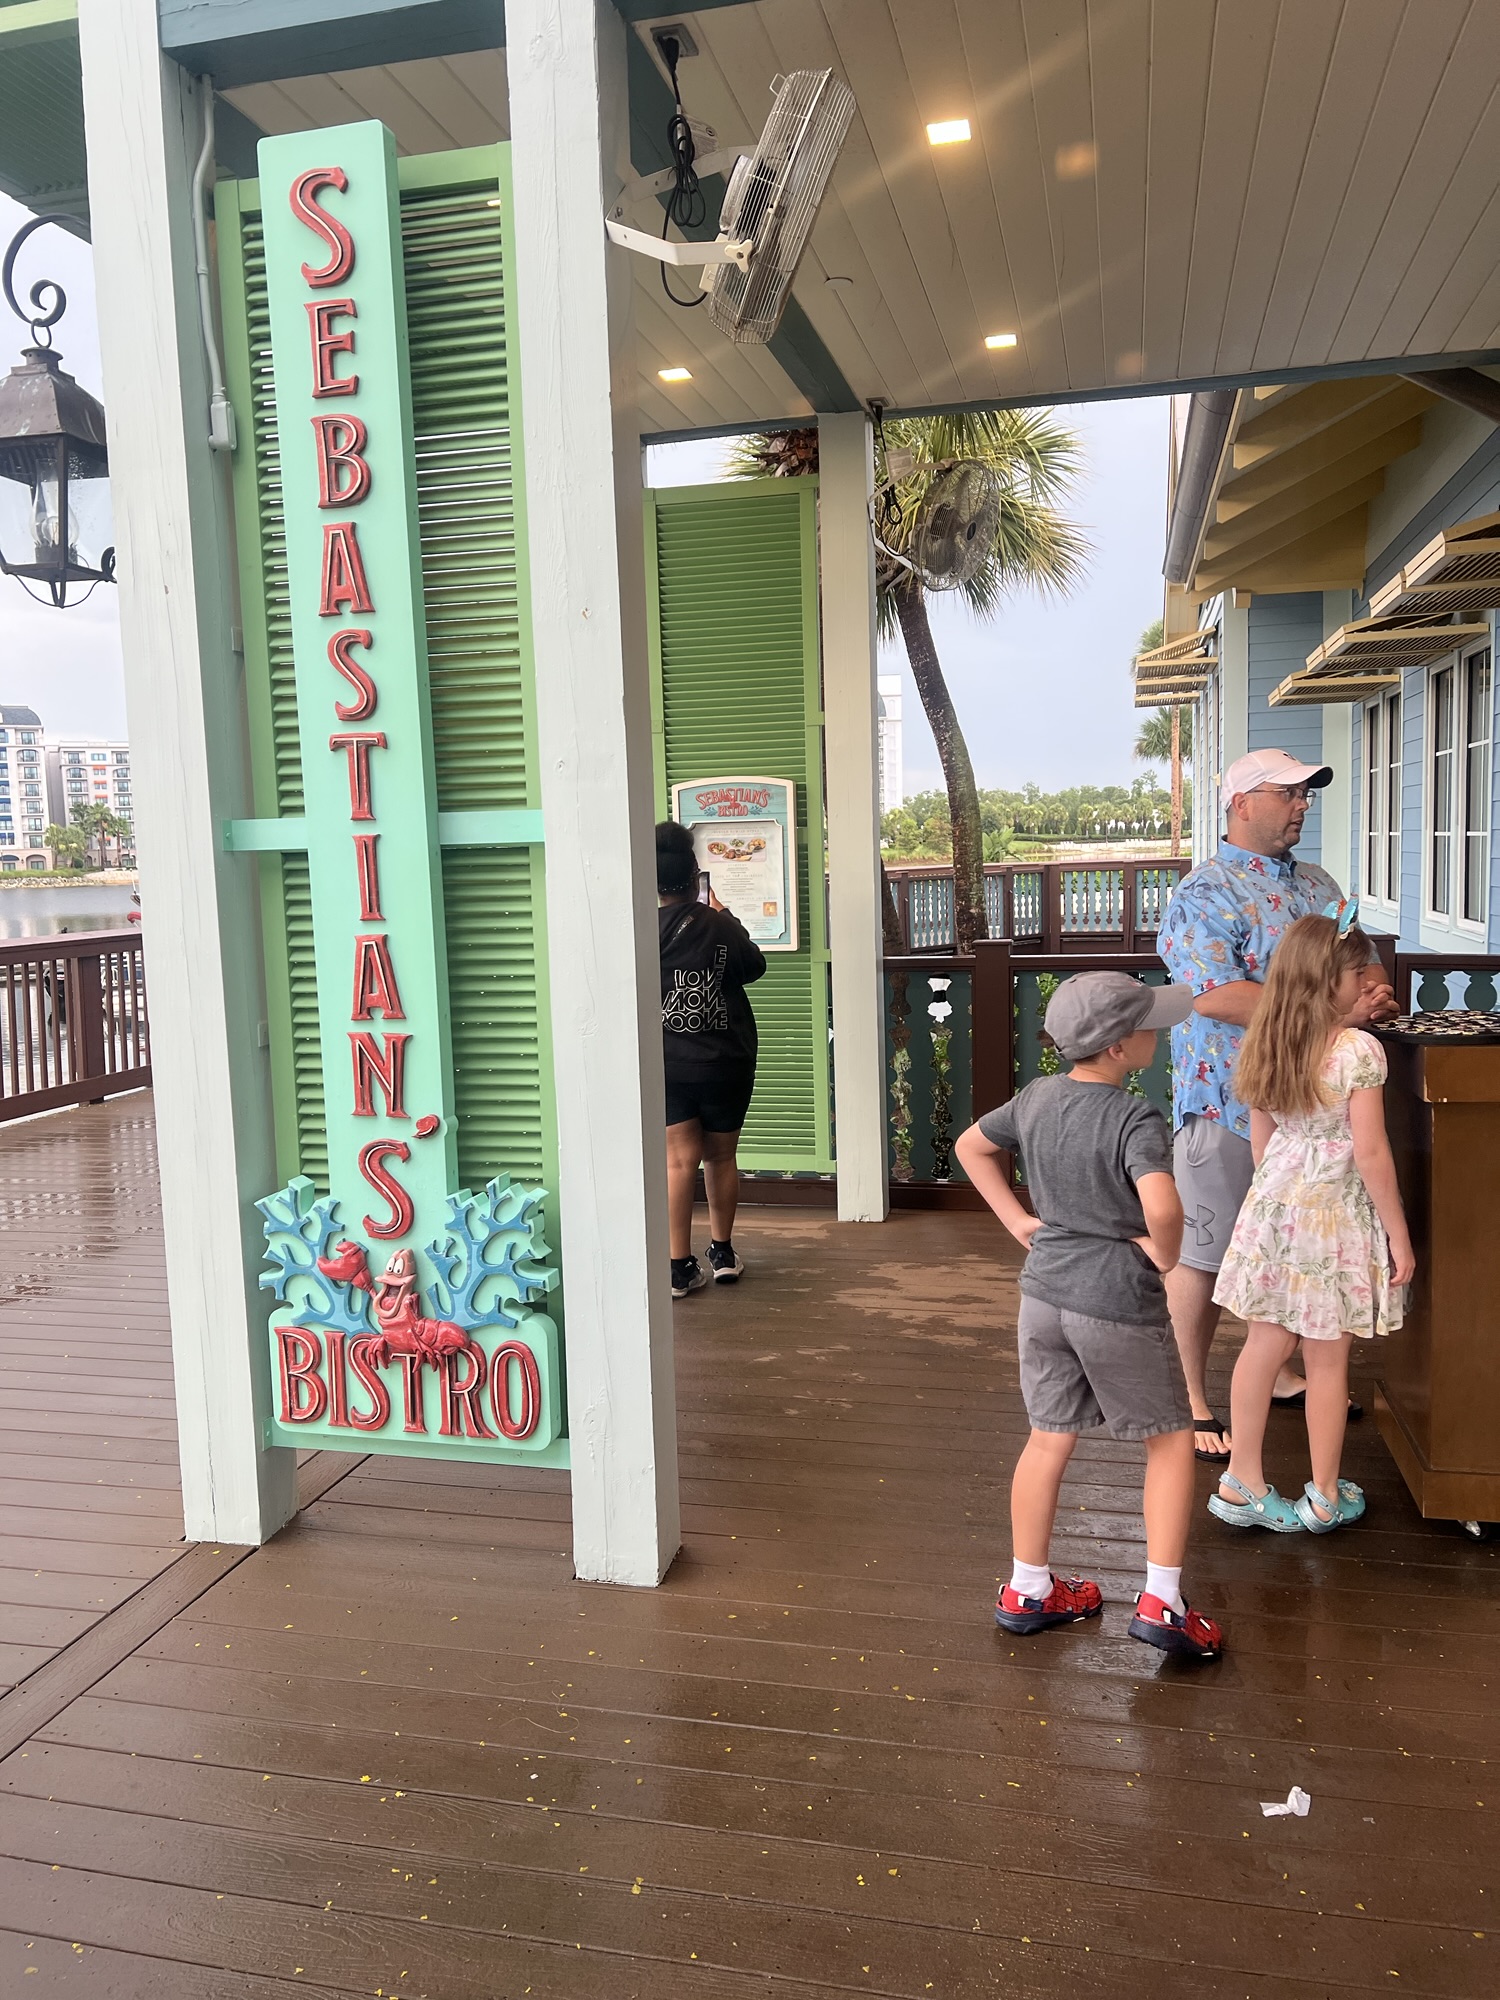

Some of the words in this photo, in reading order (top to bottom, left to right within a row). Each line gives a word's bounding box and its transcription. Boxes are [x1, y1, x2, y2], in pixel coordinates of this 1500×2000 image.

[289, 166, 440, 1240] SEBASTIAN'S
[661, 1009, 728, 1032] OOVE
[273, 1326, 542, 1441] BISTRO
